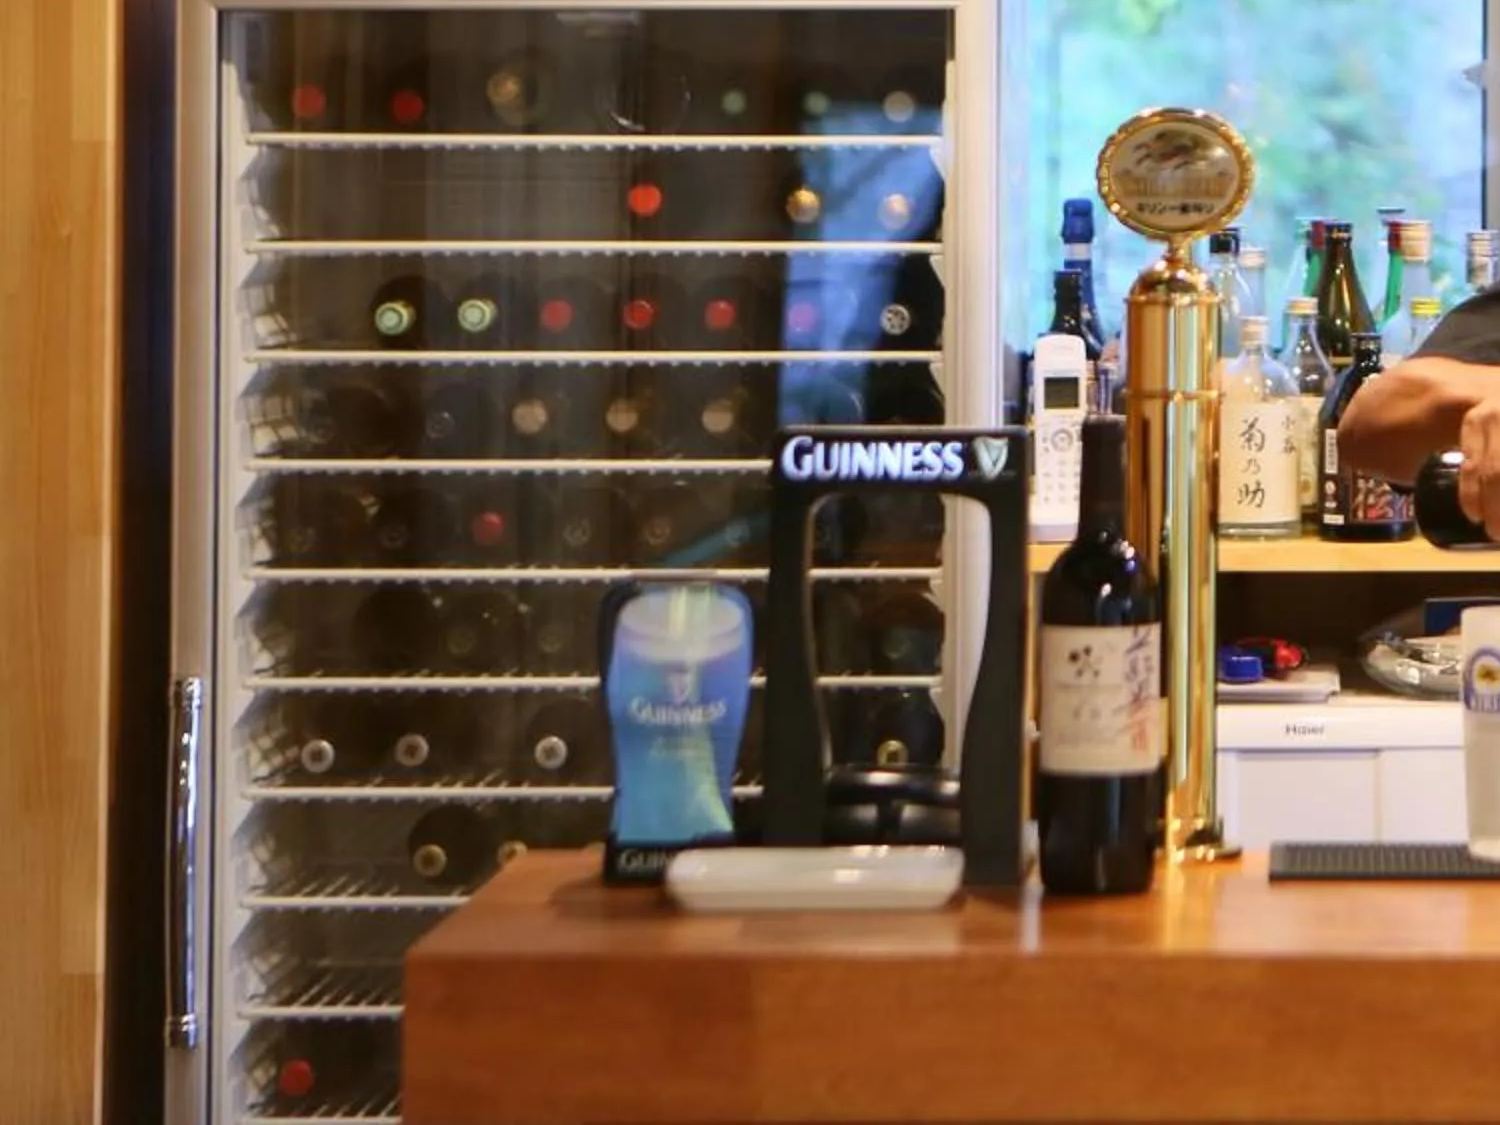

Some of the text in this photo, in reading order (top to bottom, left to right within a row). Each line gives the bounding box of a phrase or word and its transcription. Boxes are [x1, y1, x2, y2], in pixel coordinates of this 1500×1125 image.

[781, 435, 965, 481] GUINNESS
[629, 695, 727, 726] GUINNESS
[619, 848, 672, 873] GUIN
